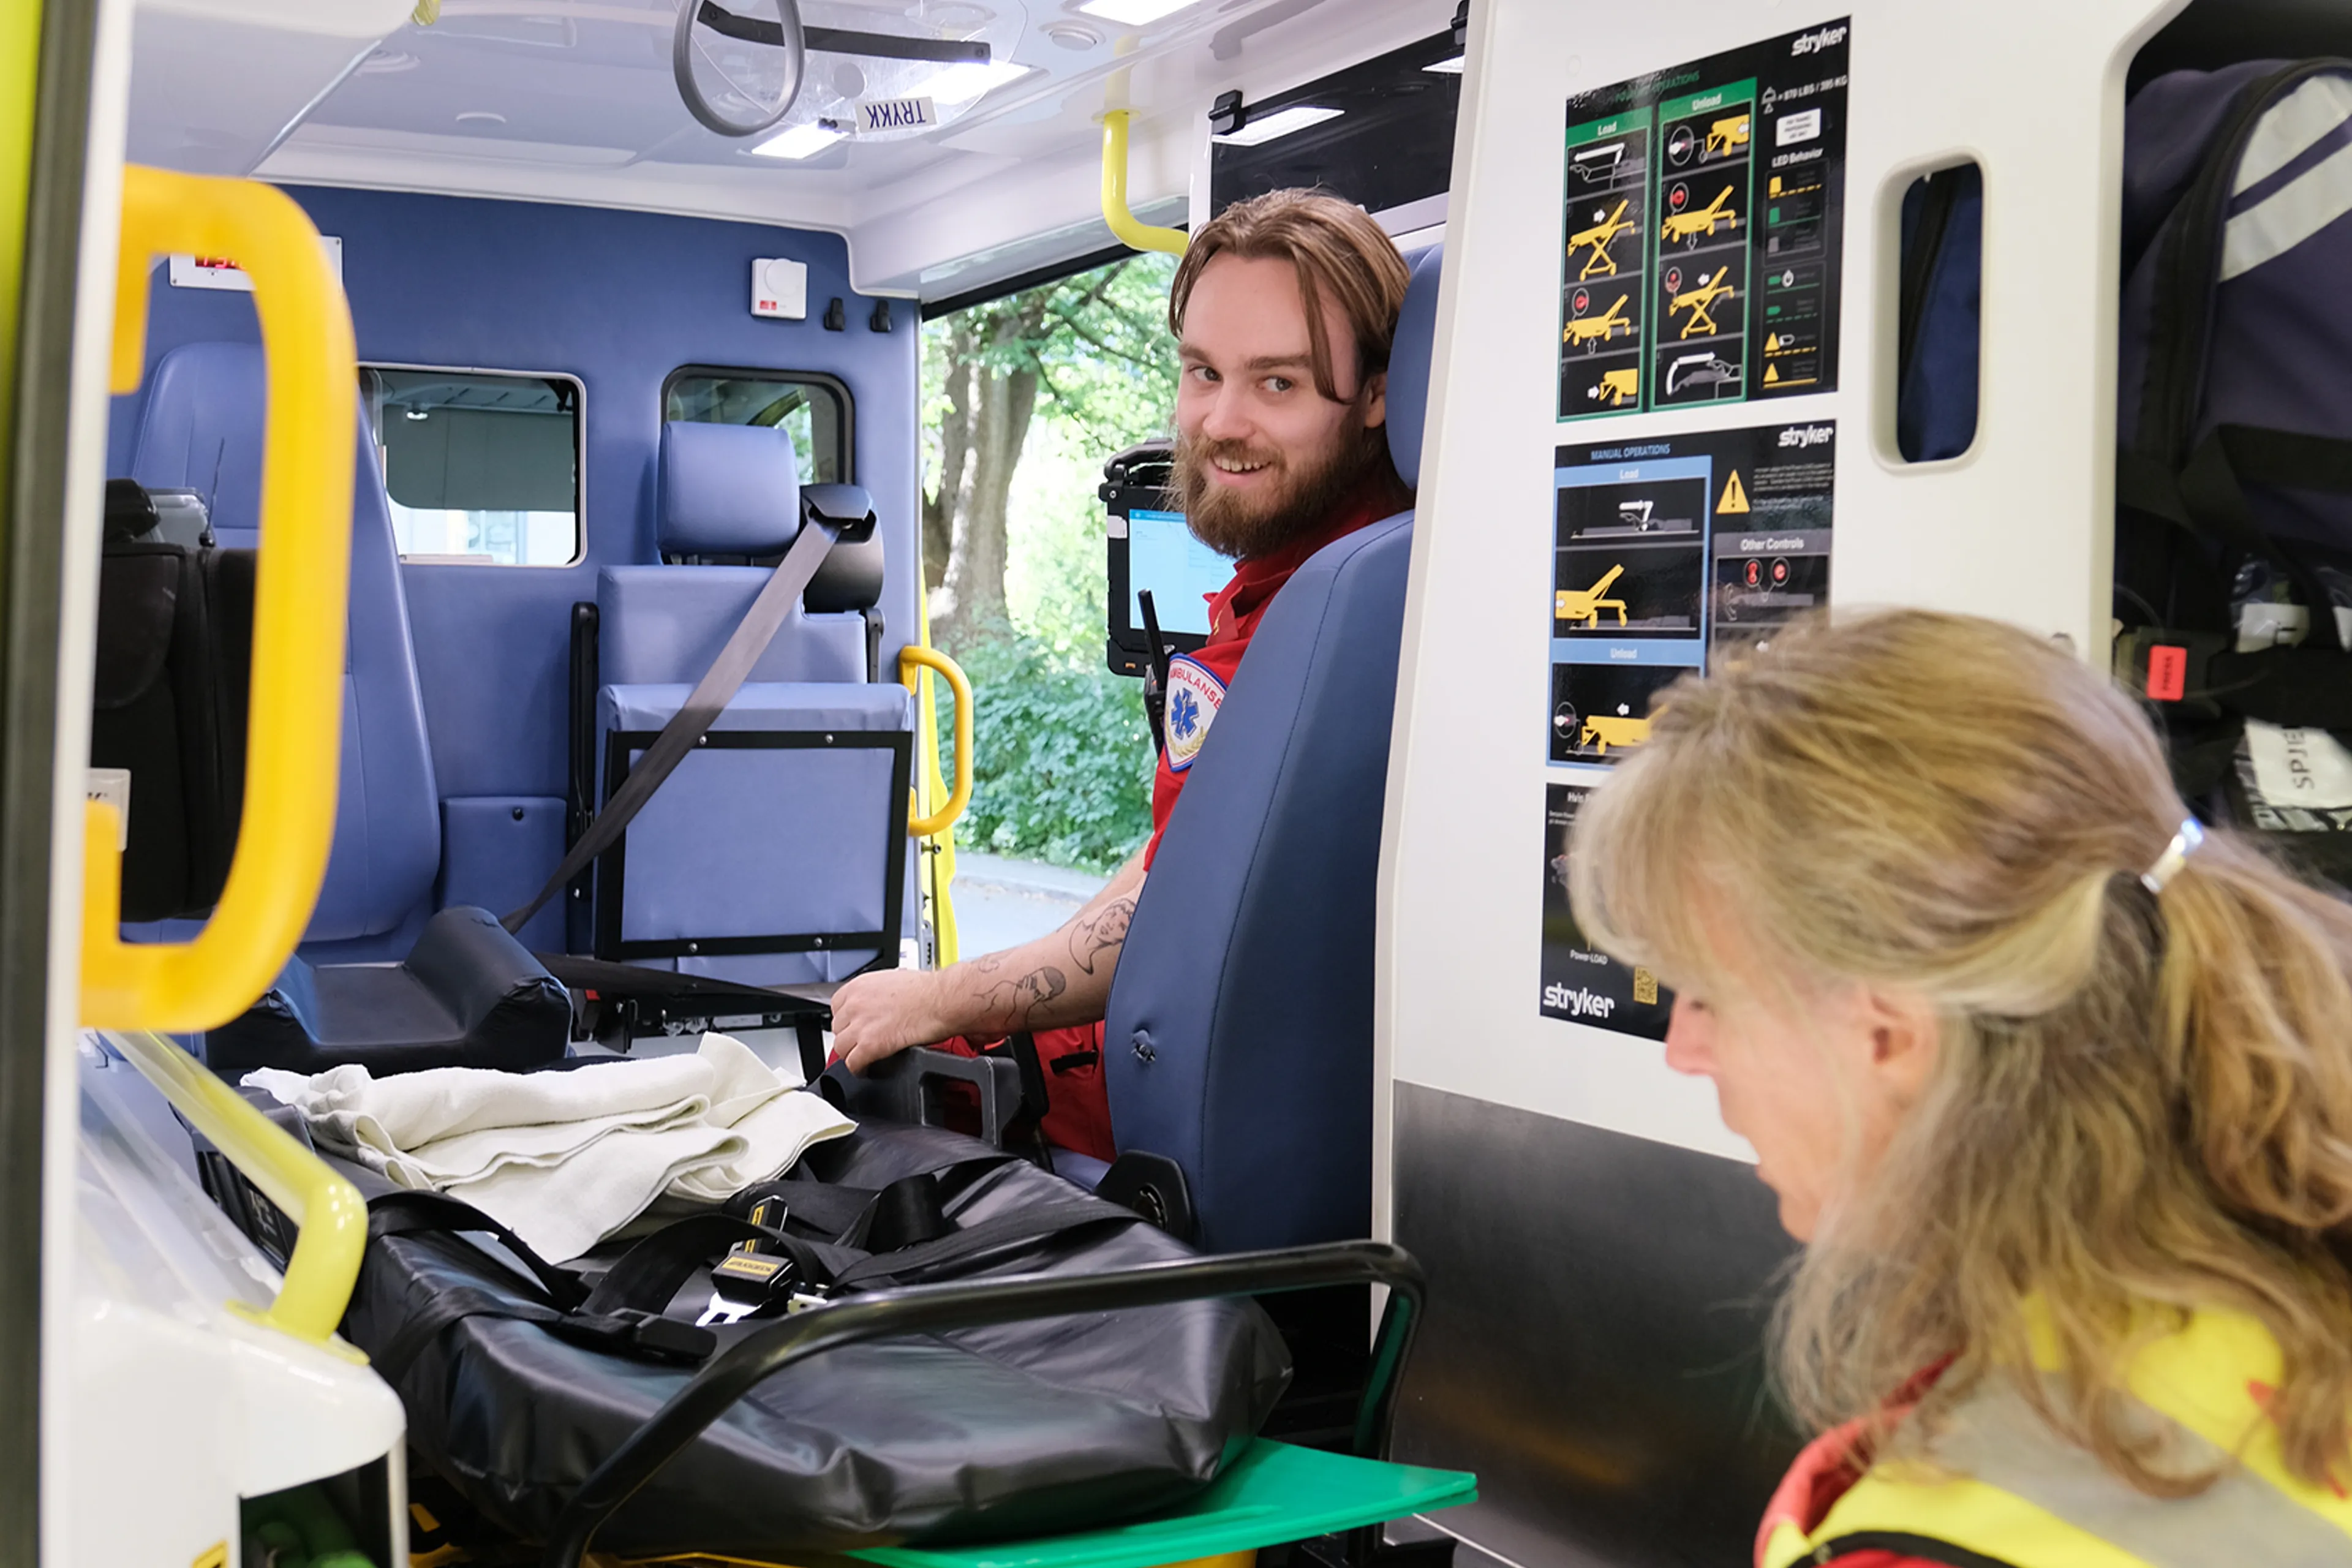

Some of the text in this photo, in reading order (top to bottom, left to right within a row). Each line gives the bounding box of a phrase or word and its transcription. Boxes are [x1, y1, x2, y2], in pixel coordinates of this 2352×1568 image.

[1791, 26, 1847, 56] stryker
[1692, 93, 1722, 111] Unload
[865, 100, 926, 129] TRYKK
[1597, 121, 1617, 136] Load
[1771, 154, 1789, 168] LED
[1778, 424, 1834, 448] stryker
[1591, 443, 1671, 461] MANUAL OPERATIONS
[1619, 468, 1639, 480] Load
[1740, 537, 1804, 551] Other Controls
[1610, 647, 1637, 660] Unload
[1170, 667, 1223, 710] MBULANSE
[1543, 982, 1615, 1019] stryker
